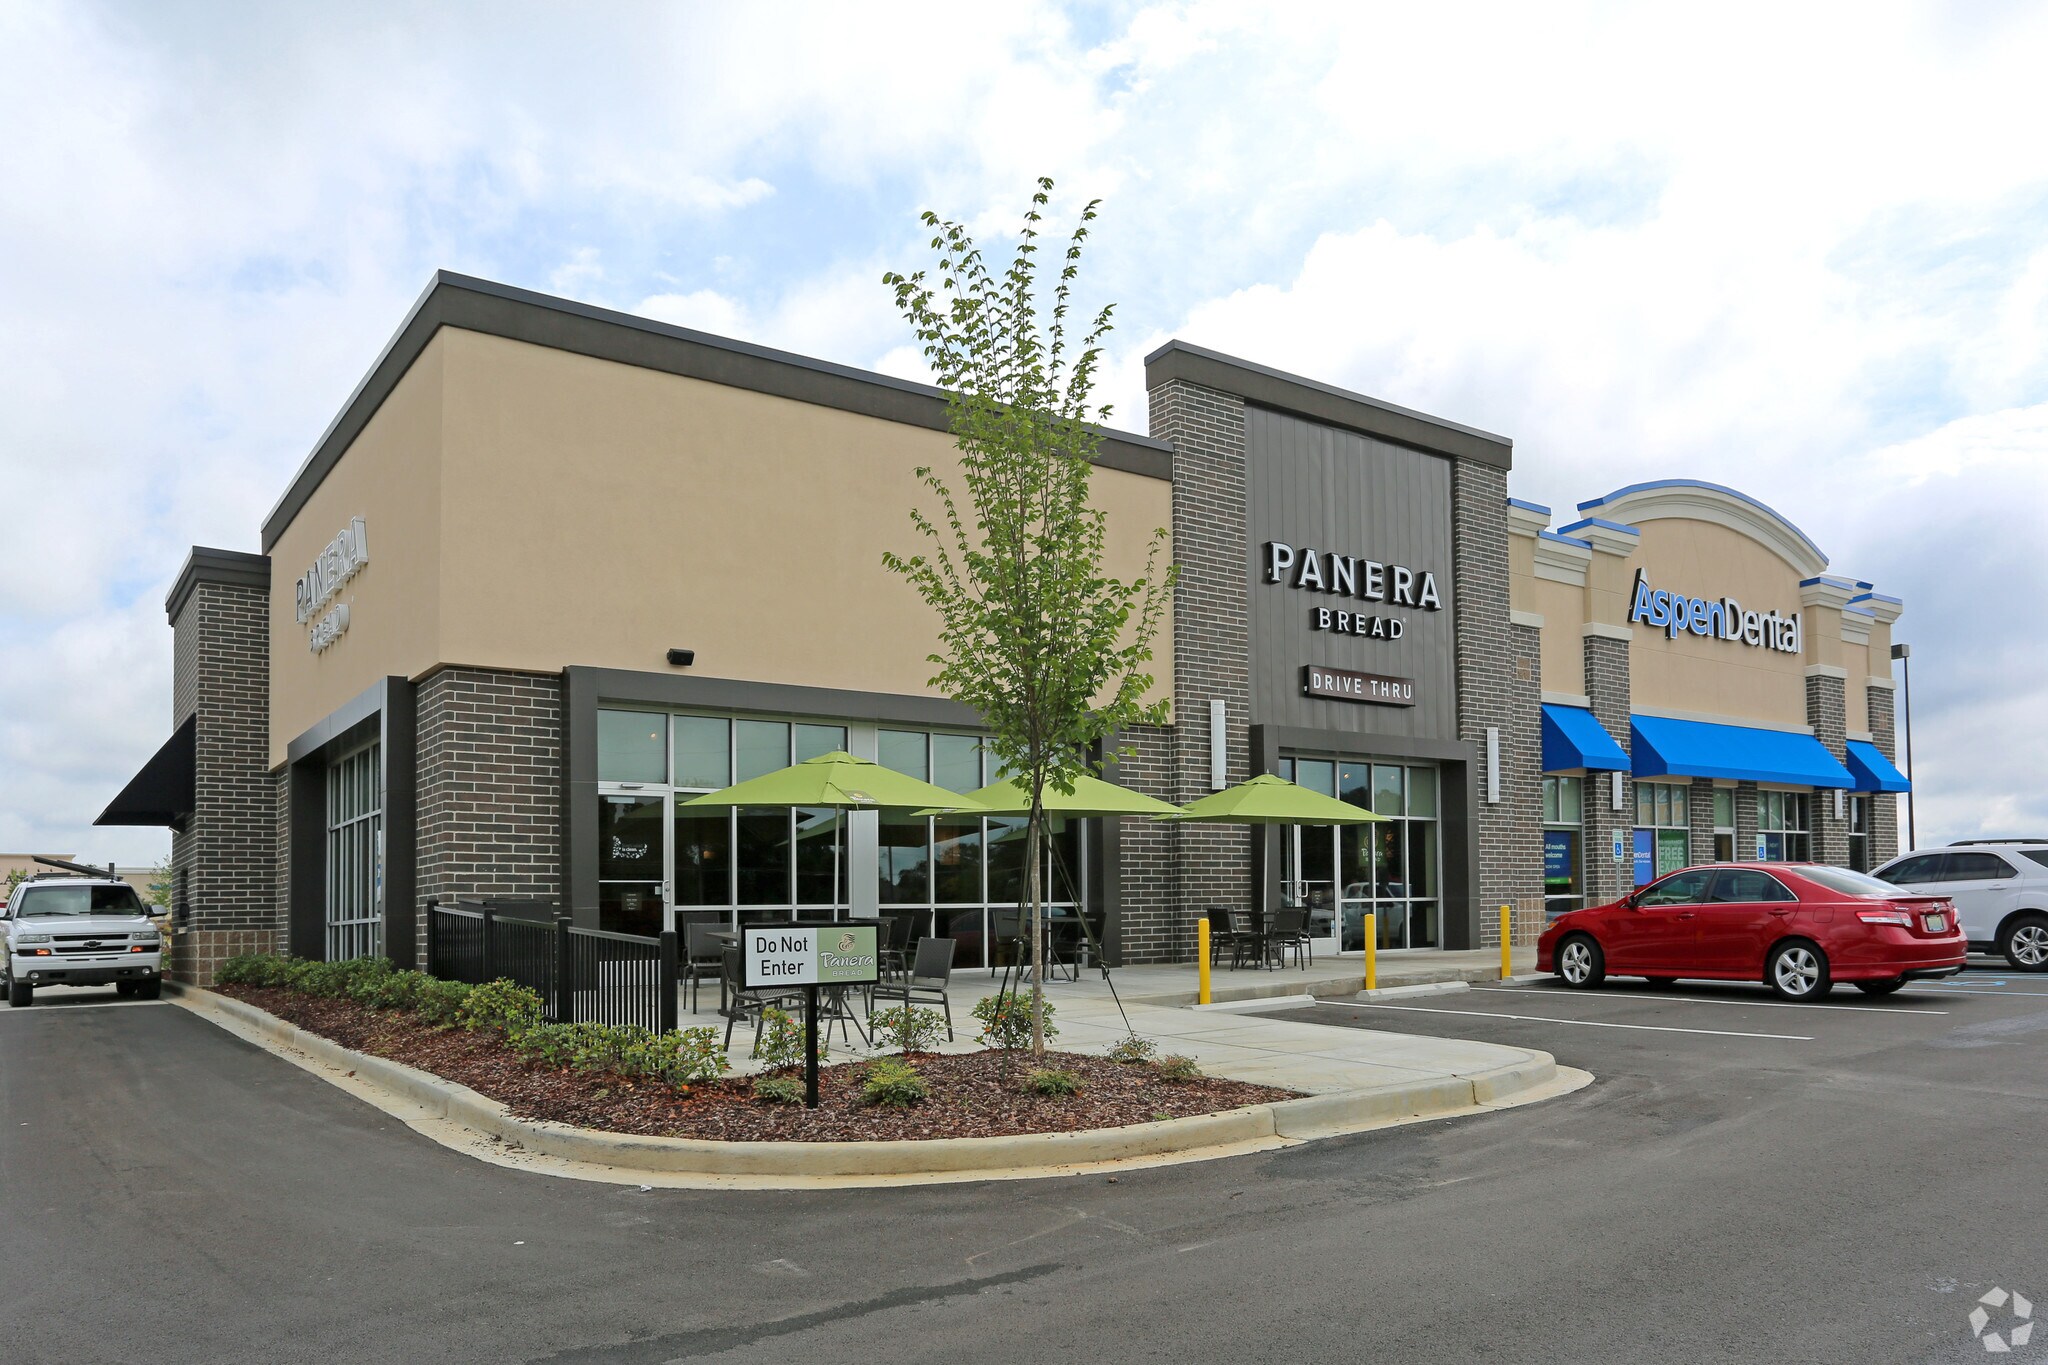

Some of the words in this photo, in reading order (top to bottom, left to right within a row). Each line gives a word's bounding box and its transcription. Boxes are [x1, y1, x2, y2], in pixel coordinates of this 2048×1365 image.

[296, 516, 369, 624] PANERA
[1268, 541, 1442, 610] PANERA
[1317, 607, 1404, 639] BREAD
[1313, 672, 1362, 694] DRIVE
[1370, 680, 1412, 699] THRU
[1658, 847, 1684, 861] FREE
[1659, 860, 1684, 873] EXAM
[756, 937, 777, 953] Do
[781, 936, 808, 952] Not
[761, 959, 804, 976] Enter
[820, 951, 874, 968] Panera
[832, 969, 863, 977] BREAD
